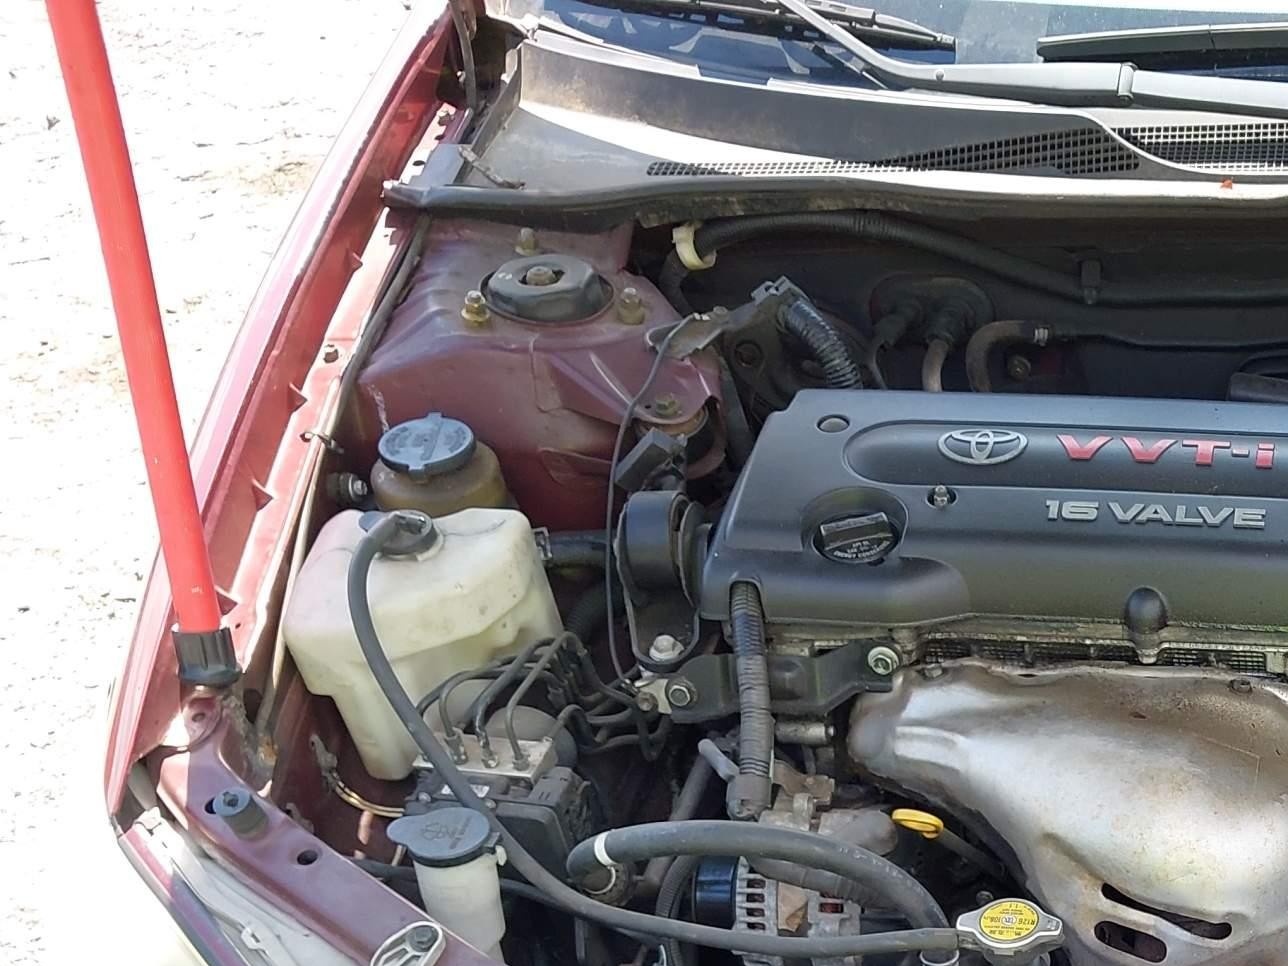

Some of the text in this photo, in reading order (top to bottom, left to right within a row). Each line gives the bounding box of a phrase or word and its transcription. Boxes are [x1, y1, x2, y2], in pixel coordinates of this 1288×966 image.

[1056, 434, 1275, 469] VVT-i
[1045, 499, 1267, 529] 16 VALVE
